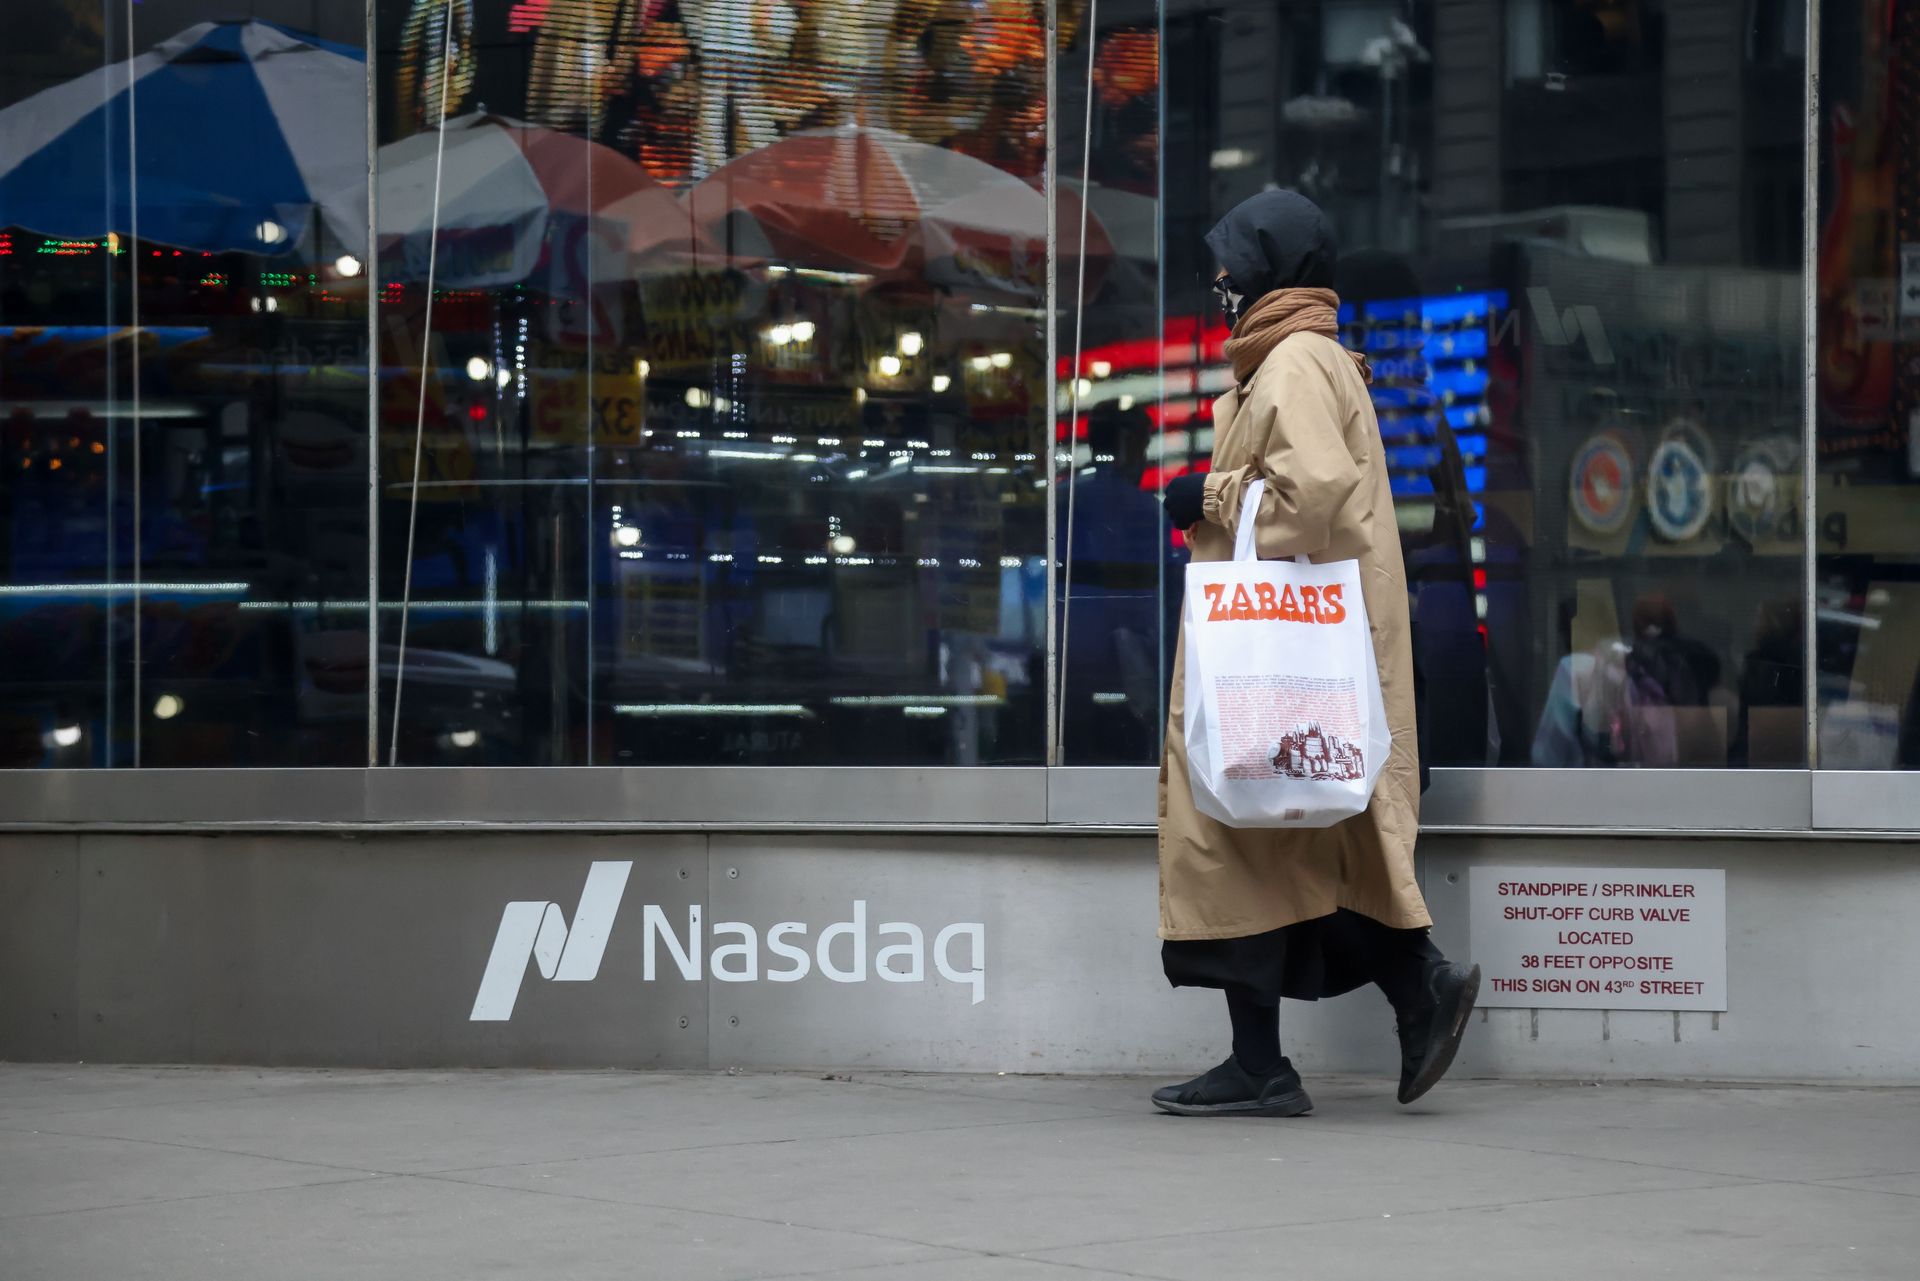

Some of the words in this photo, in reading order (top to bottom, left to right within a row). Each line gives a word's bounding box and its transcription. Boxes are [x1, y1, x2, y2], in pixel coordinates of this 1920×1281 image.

[1204, 582, 1346, 625] ZABAR'S
[1497, 882, 1588, 897] STANDPIPE
[1592, 884, 1598, 897] /
[1601, 884, 1696, 898] SPRINKLER
[1503, 907, 1584, 921] SHUT-OFF
[1588, 908, 1634, 921] CURB
[1640, 908, 1691, 922] VALVE
[1558, 931, 1634, 945] LOCATED
[643, 900, 985, 1006] Nasdaq
[1521, 955, 1540, 968] 38
[1544, 956, 1585, 969] FEET
[1589, 956, 1673, 970] OPPOSITE
[1491, 979, 1528, 992] THIS
[1532, 979, 1572, 993] SIGN
[1576, 979, 1600, 993] ON
[1640, 981, 1705, 995] STREET
